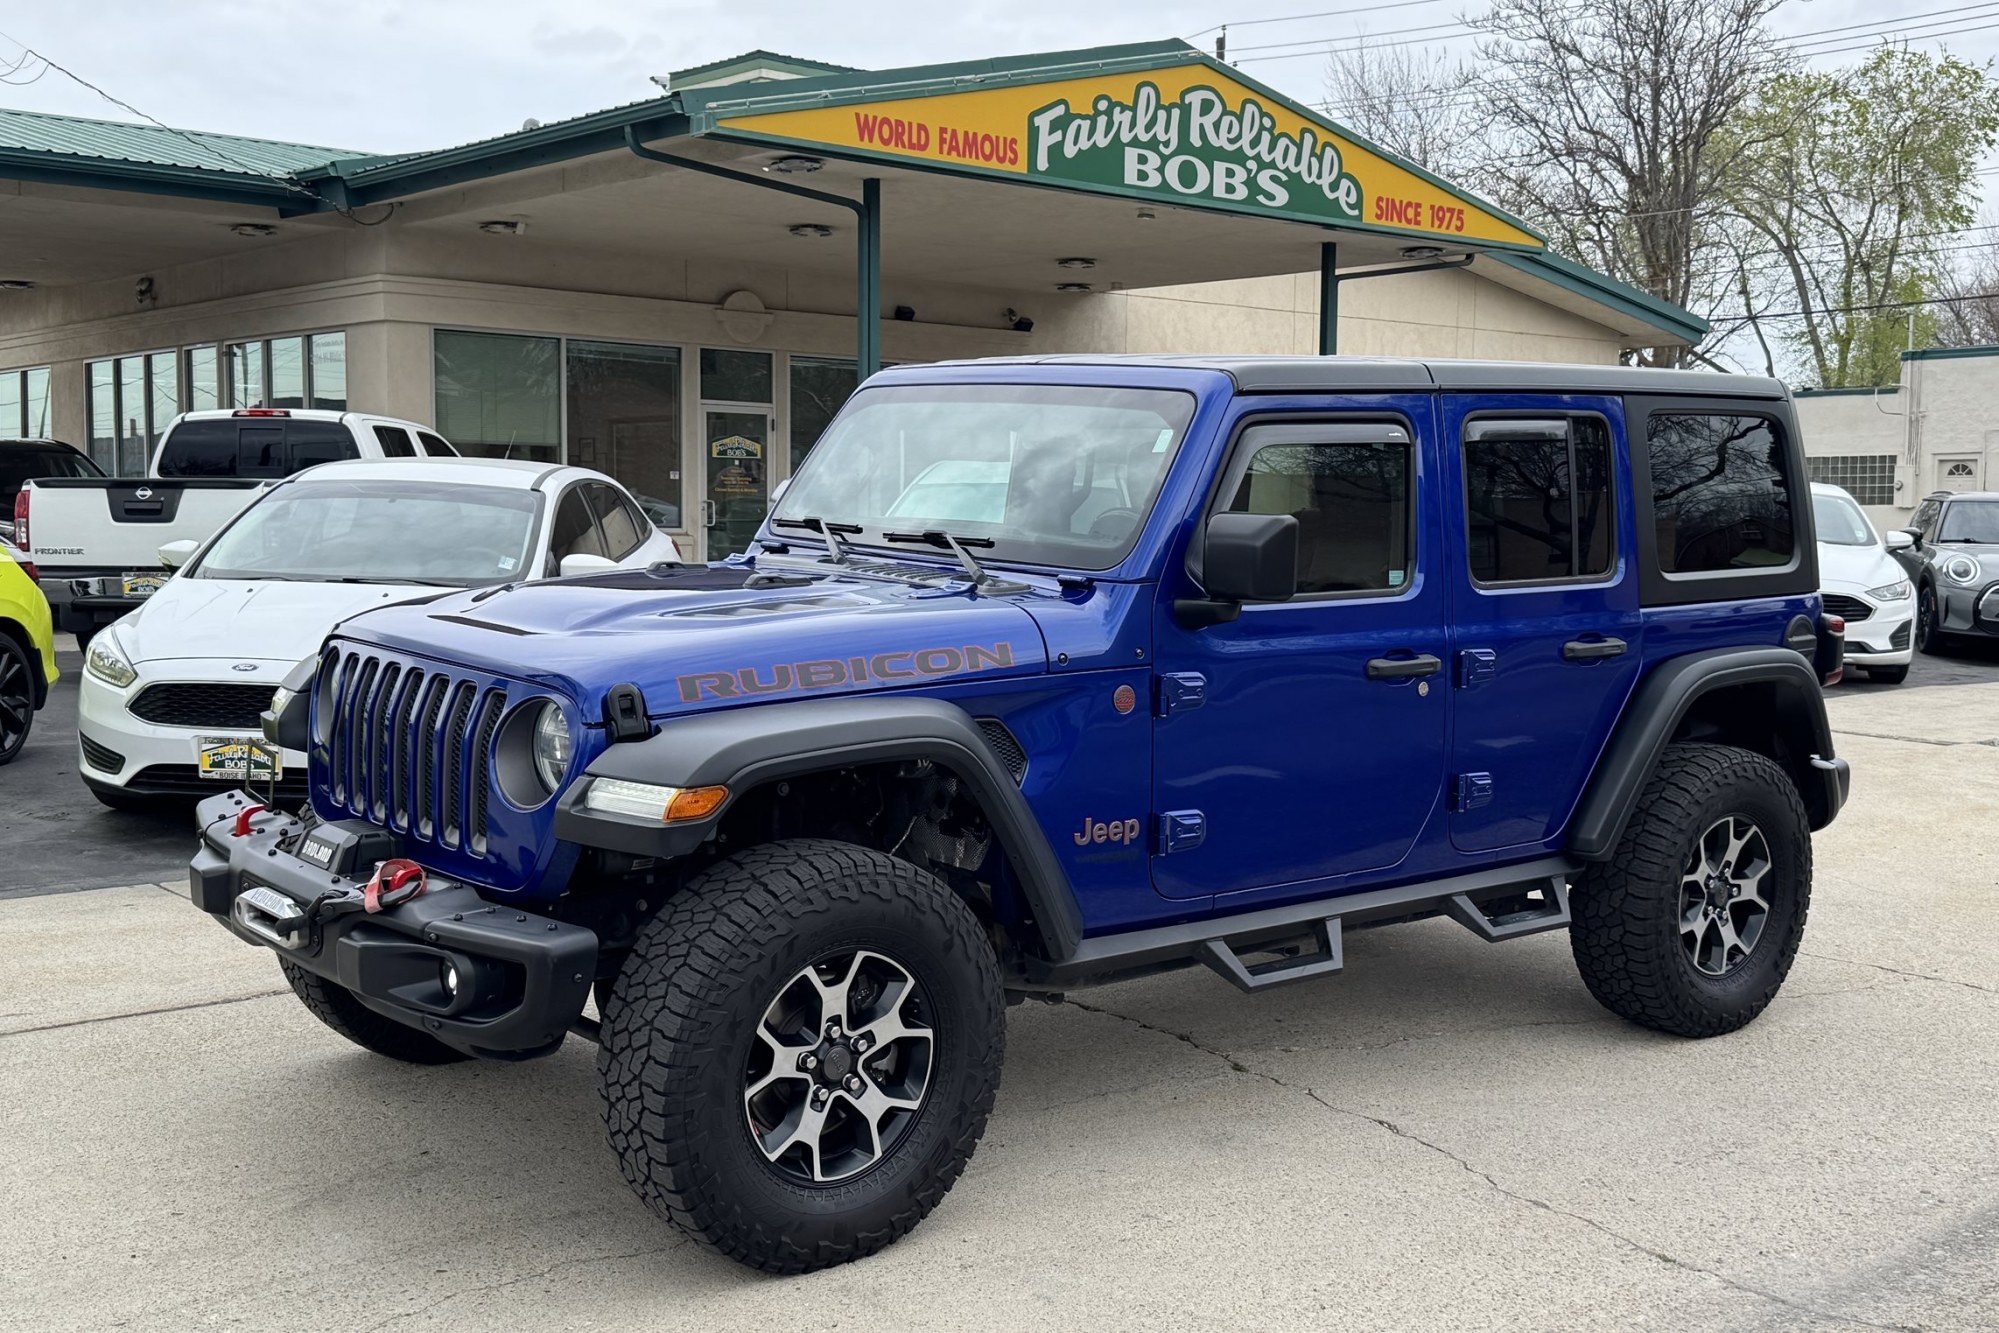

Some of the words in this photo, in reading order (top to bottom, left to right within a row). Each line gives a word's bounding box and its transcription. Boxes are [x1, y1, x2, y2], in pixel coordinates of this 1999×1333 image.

[855, 112, 930, 152] WORLD
[938, 126, 1019, 166] FAMOUS
[1033, 85, 1181, 172] Fairly
[1184, 89, 1360, 216] Reliable
[1123, 146, 1290, 207] BOB'S
[1375, 195, 1422, 226] SINCE
[1430, 204, 1465, 232] 1975
[34, 547, 85, 555] FRONTIER
[677, 642, 1014, 703] RUBICON
[301, 839, 333, 863] BADLAND
[1073, 817, 1140, 846] Jeep
